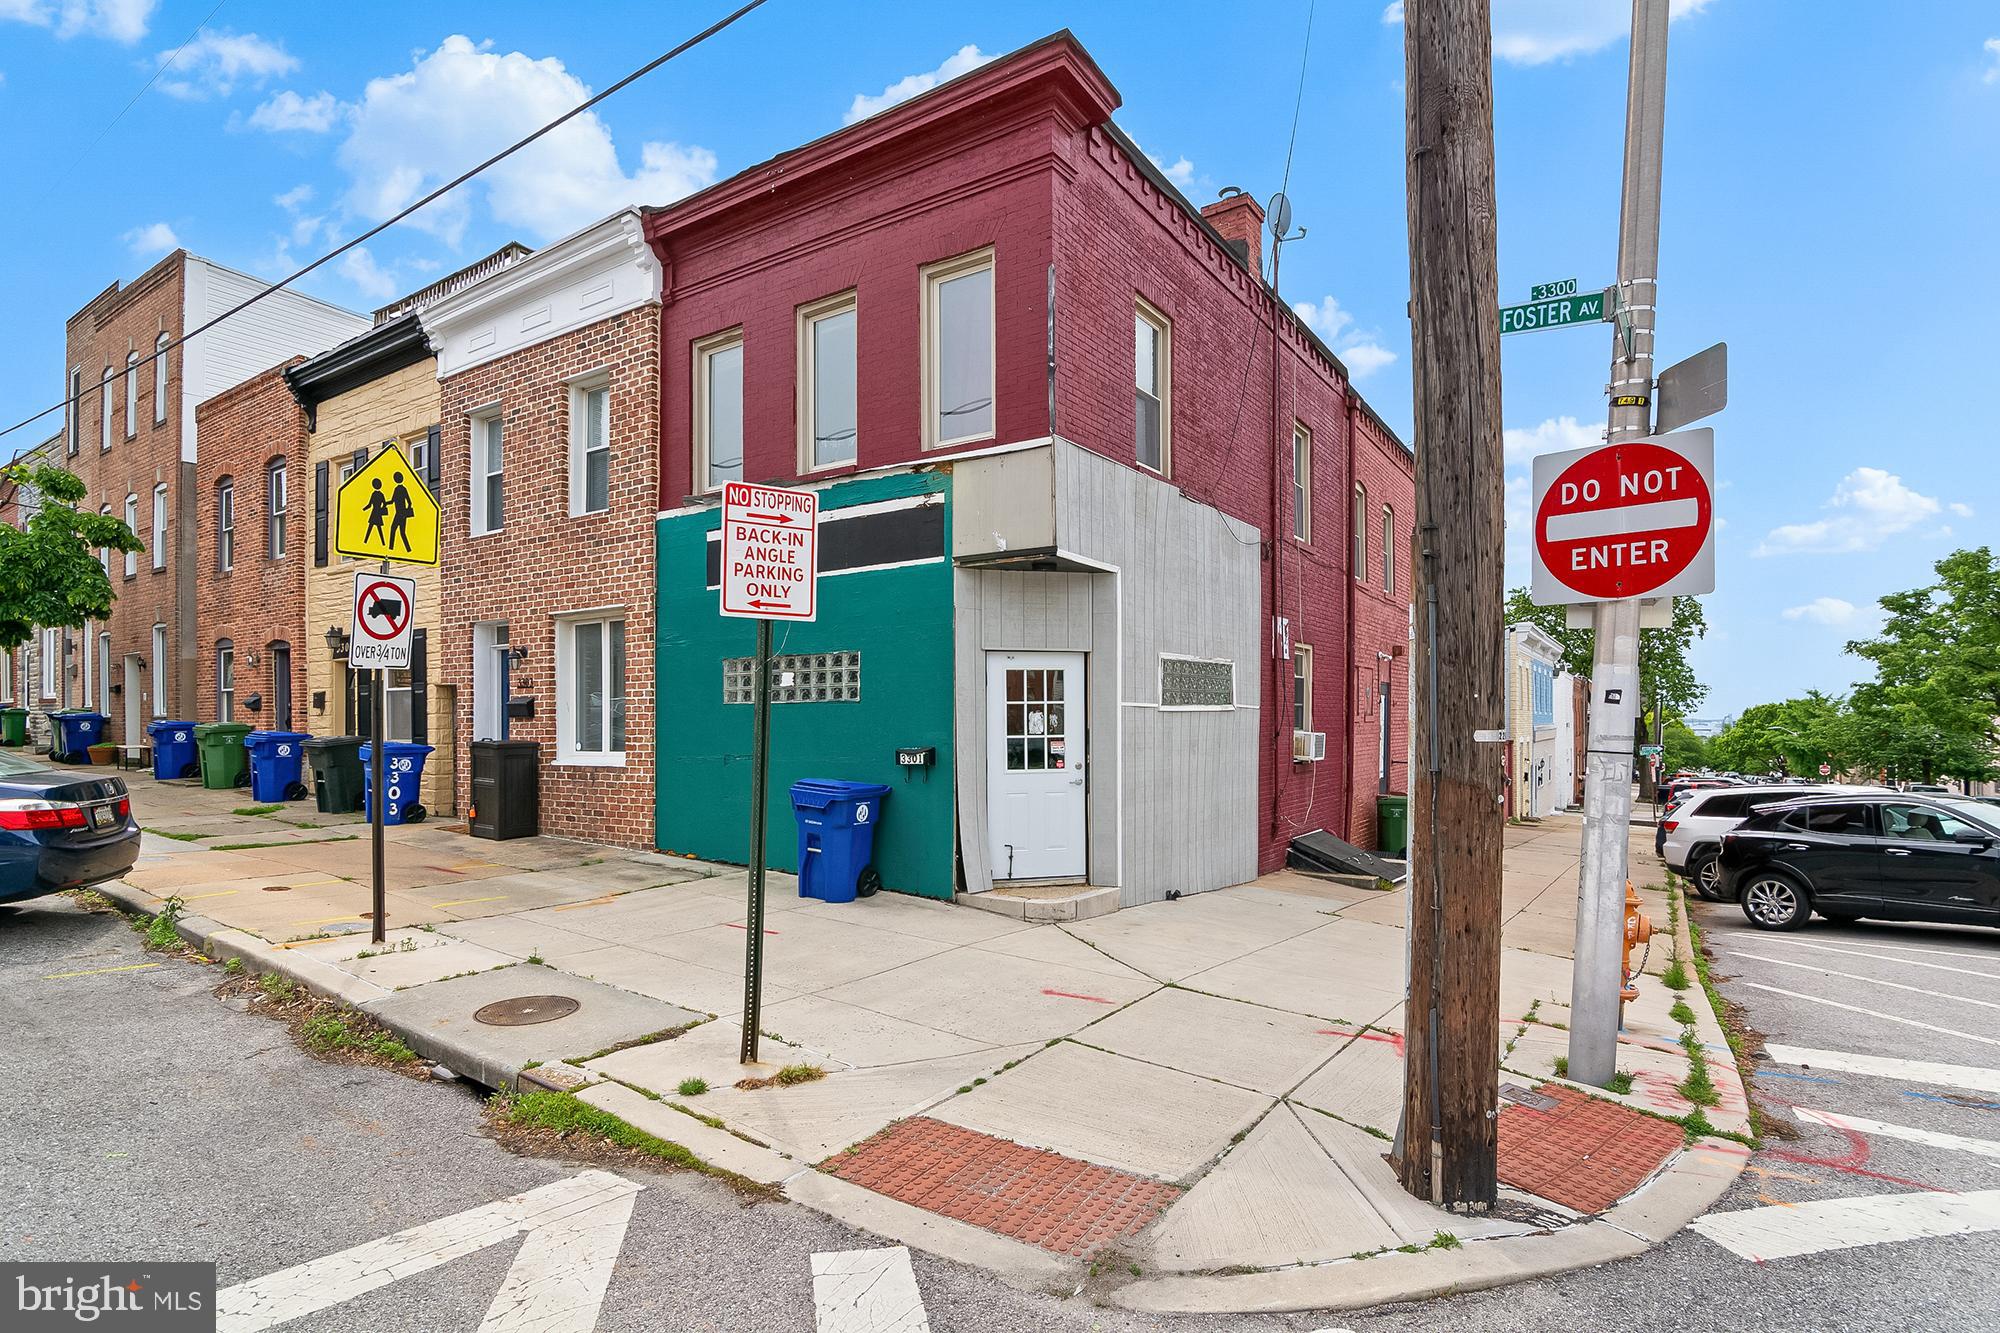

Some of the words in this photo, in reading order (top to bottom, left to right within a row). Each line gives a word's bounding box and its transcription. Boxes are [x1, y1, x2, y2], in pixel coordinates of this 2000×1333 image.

[1538, 280, 1576, 299] 3300
[1502, 301, 1571, 331] FOSTER
[1579, 300, 1599, 316] AV.
[1561, 479, 1601, 505] DO
[1620, 466, 1683, 497] NOT
[729, 487, 750, 505] NO
[754, 491, 811, 513] STOPPING
[736, 526, 804, 547] BACK-IN
[744, 546, 796, 564] ANGLE
[1571, 539, 1669, 571] ENTER
[734, 562, 804, 582] PARKING
[746, 582, 791, 598] ONLY
[355, 645, 377, 659] OVER
[376, 644, 390, 662] 3/4
[390, 647, 407, 660] TON
[900, 753, 923, 764] 3301
[388, 757, 401, 816] 3303
